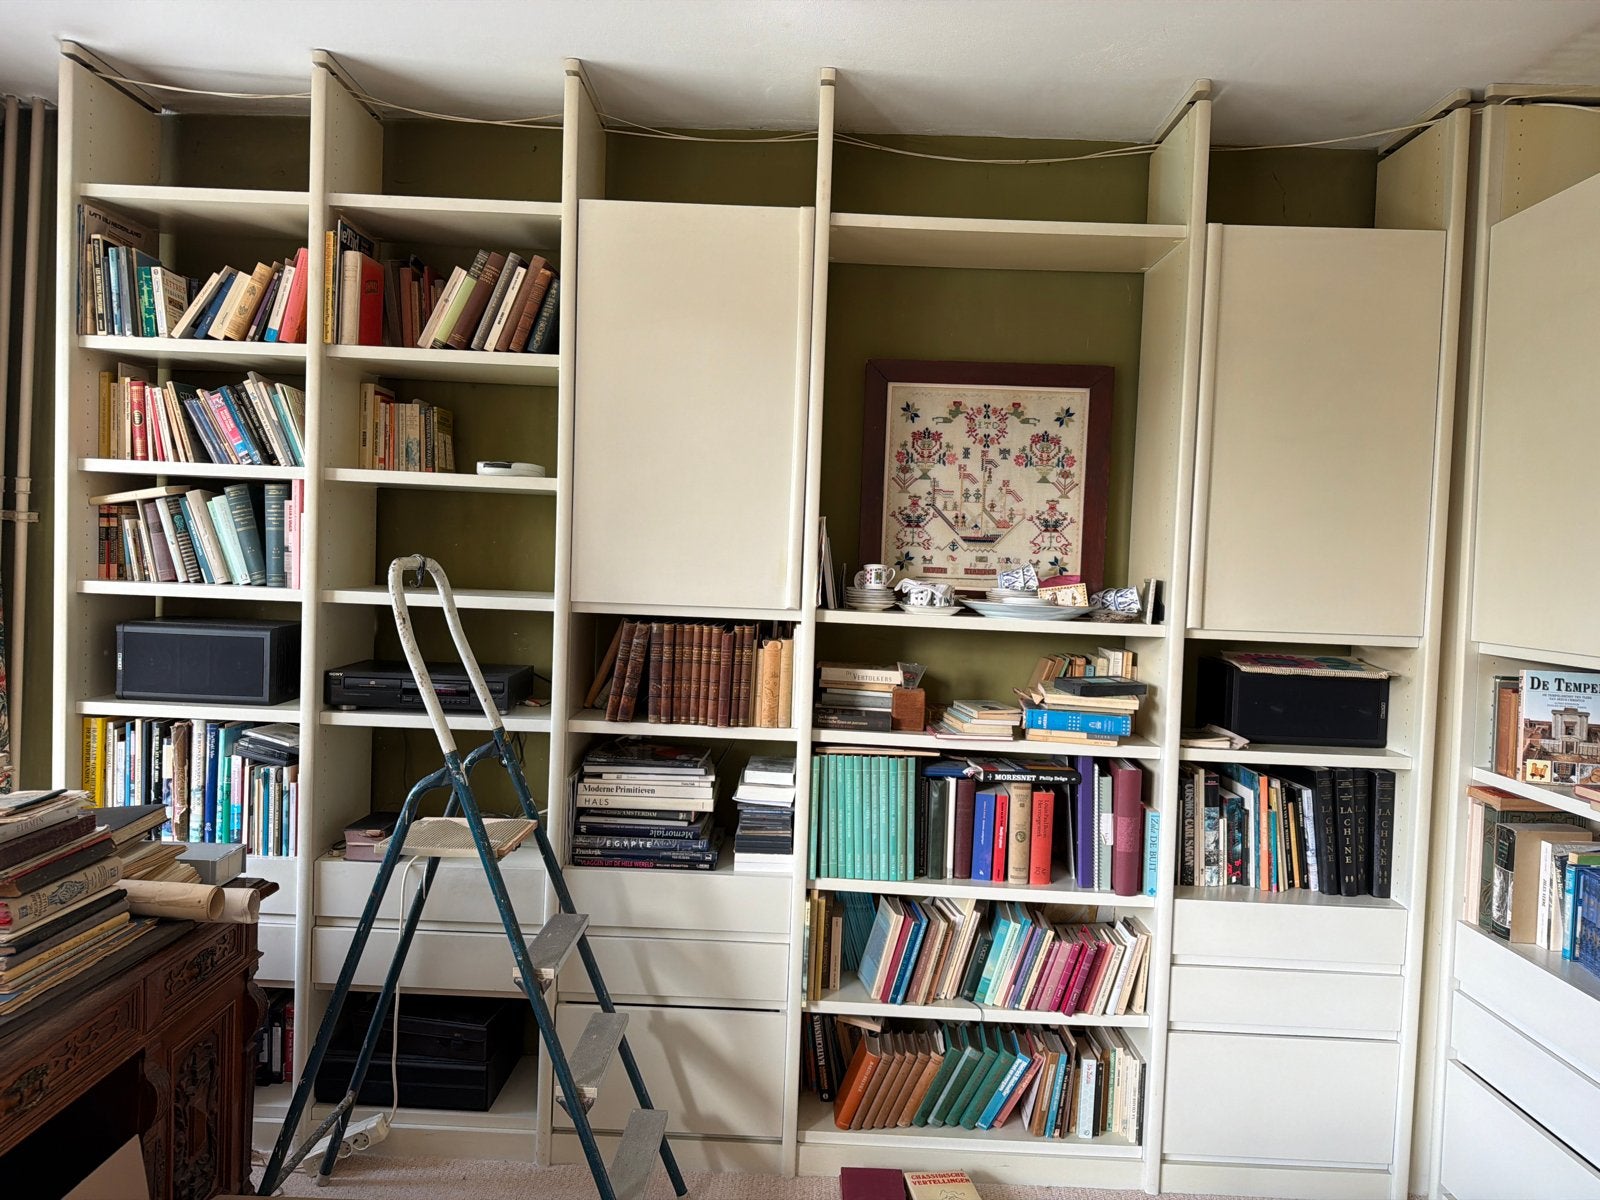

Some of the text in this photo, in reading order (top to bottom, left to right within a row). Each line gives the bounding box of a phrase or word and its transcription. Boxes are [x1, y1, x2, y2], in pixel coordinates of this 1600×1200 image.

[854, 674, 892, 682] VERTOLKERS
[615, 786, 656, 794] Primitieven
[1184, 784, 1194, 866] COSMOS CARL SAGAN
[650, 830, 693, 838] Memoriale
[1150, 835, 1157, 848] DE
[1344, 819, 1352, 864] CHINE
[813, 1015, 824, 1065] KATECHISMUS
[911, 1172, 966, 1180] CHASSIDISCHE
